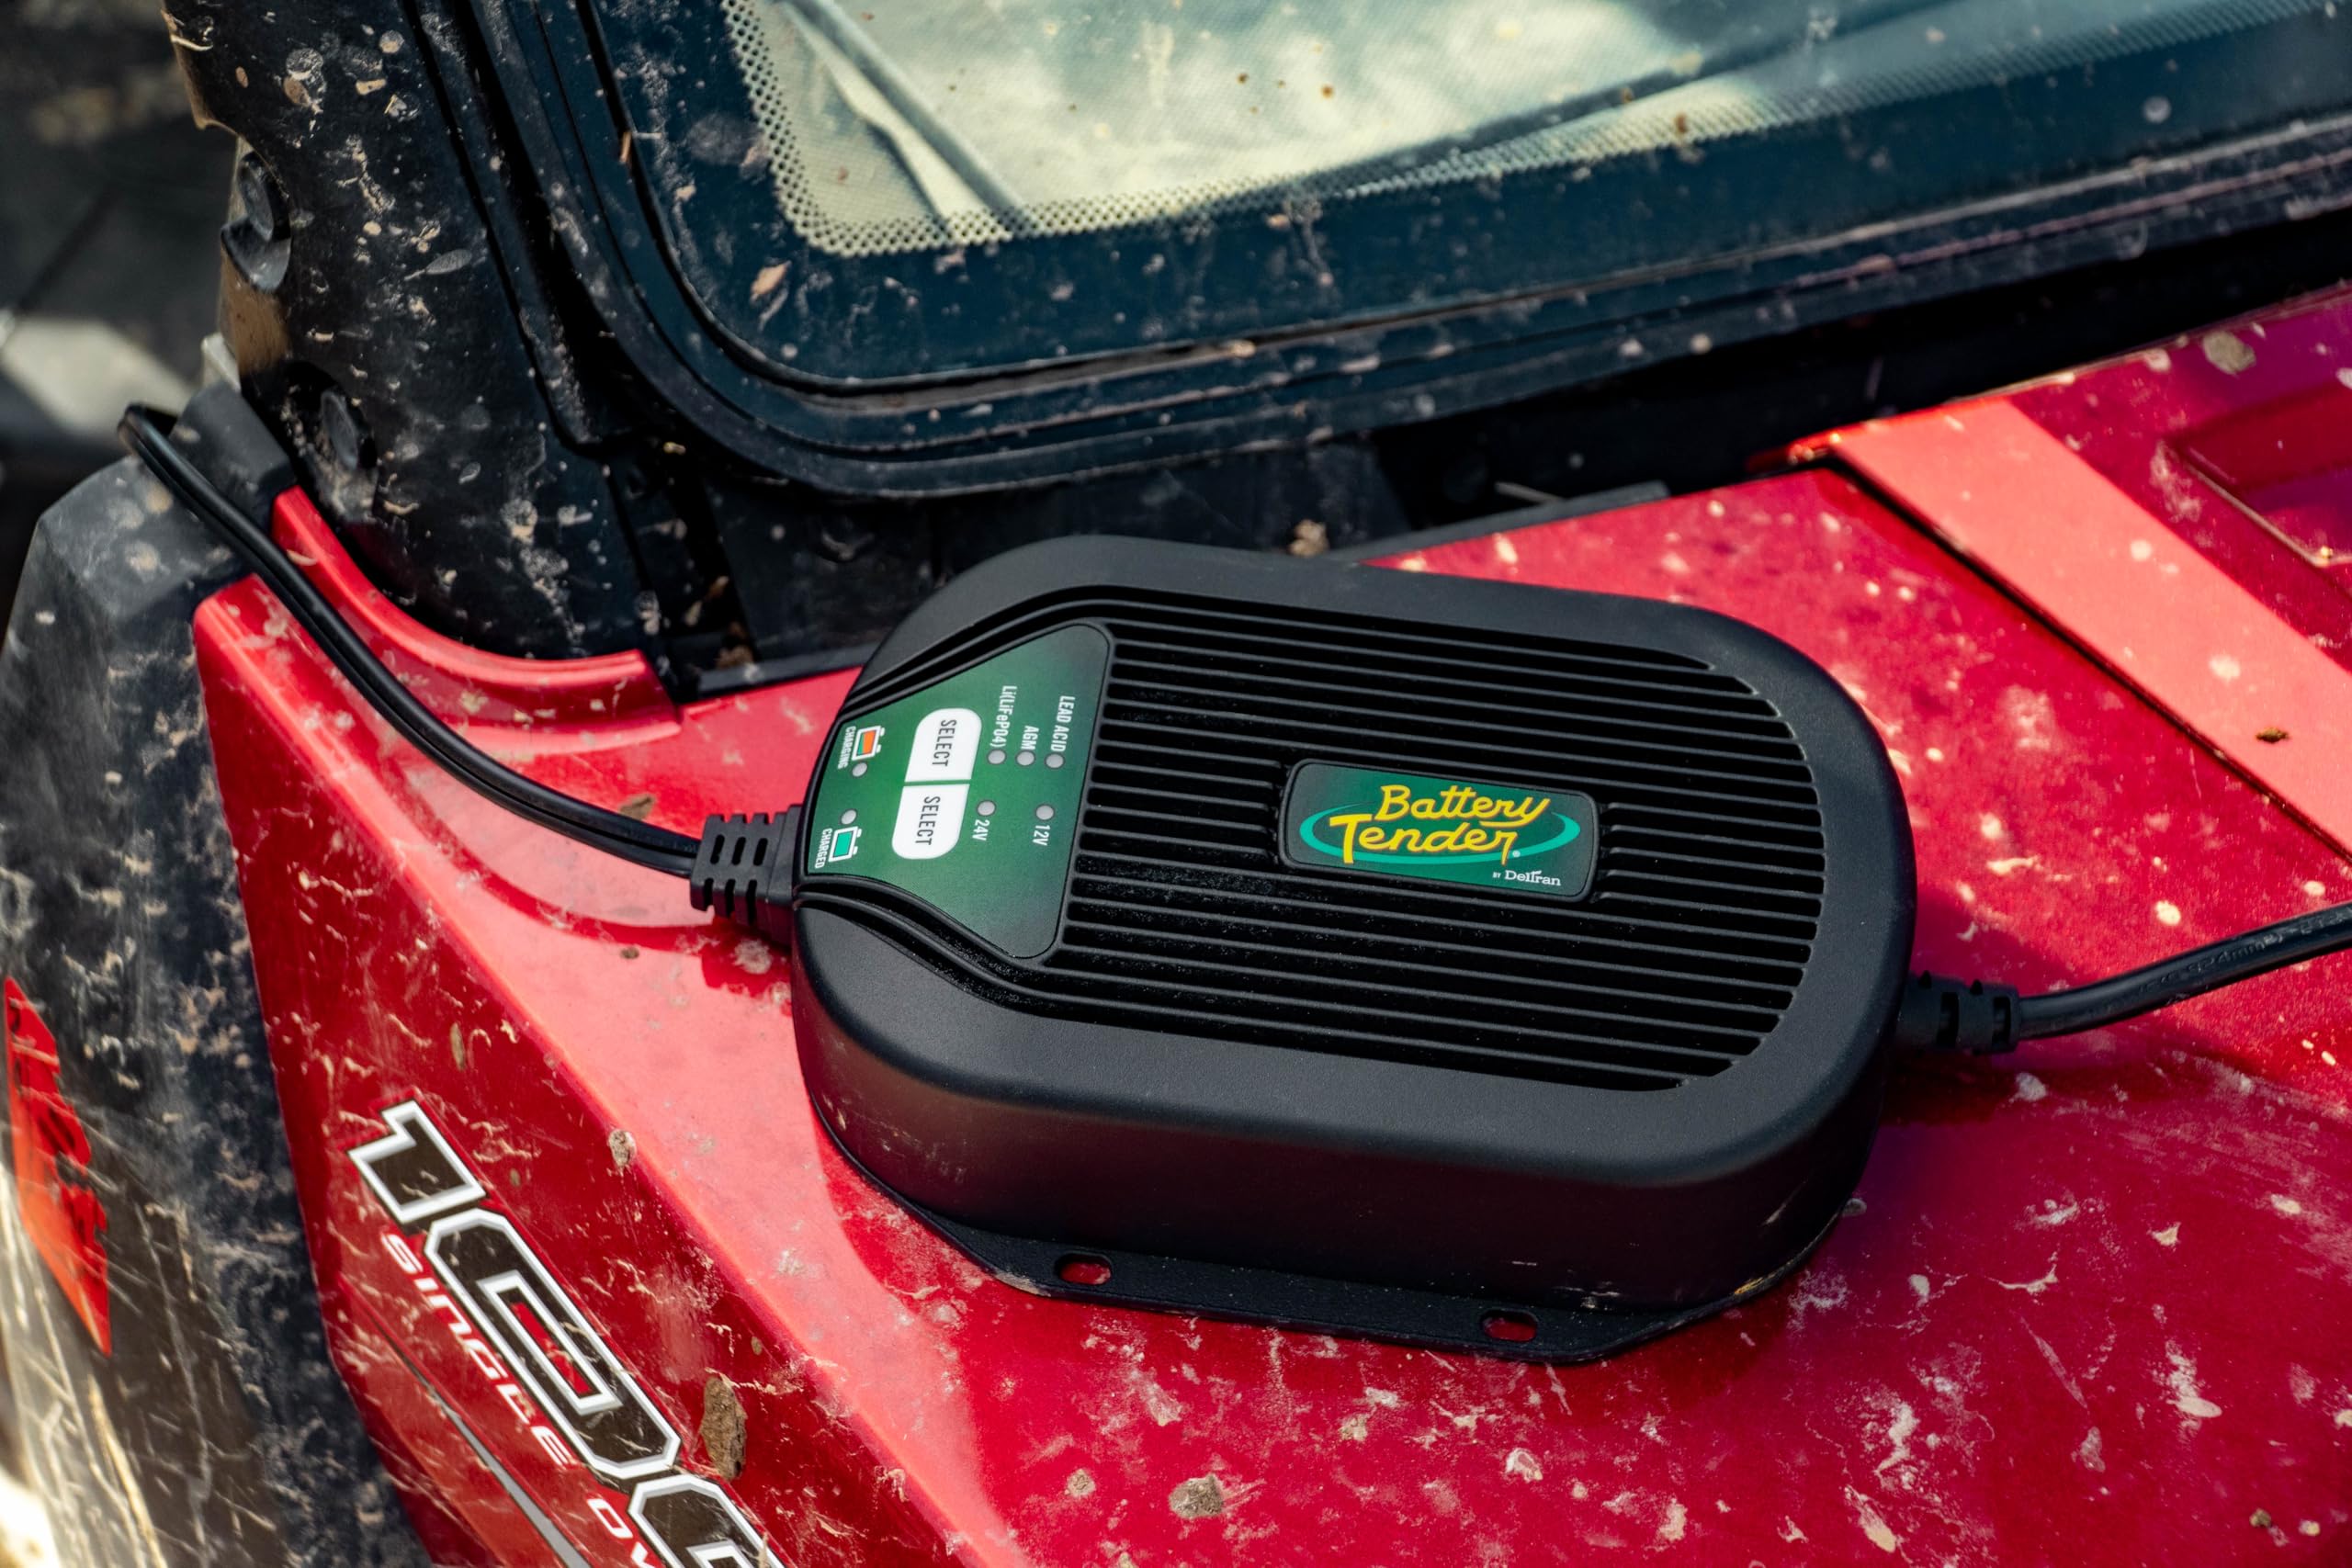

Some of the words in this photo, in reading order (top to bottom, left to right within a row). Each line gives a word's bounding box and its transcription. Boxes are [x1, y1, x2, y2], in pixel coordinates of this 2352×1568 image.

[1056, 695, 1075, 723] LEAD
[837, 726, 856, 770] CHARGING
[932, 719, 957, 767] SELECT
[1021, 725, 1040, 750] AGM
[1050, 724, 1069, 752] ACID
[915, 795, 941, 845] SELECT
[1373, 784, 1551, 828] Battery
[814, 828, 832, 869] CHARGED
[972, 819, 990, 841] 24V
[1032, 824, 1051, 846] 12V
[379, 1233, 576, 1468] SINGLE
